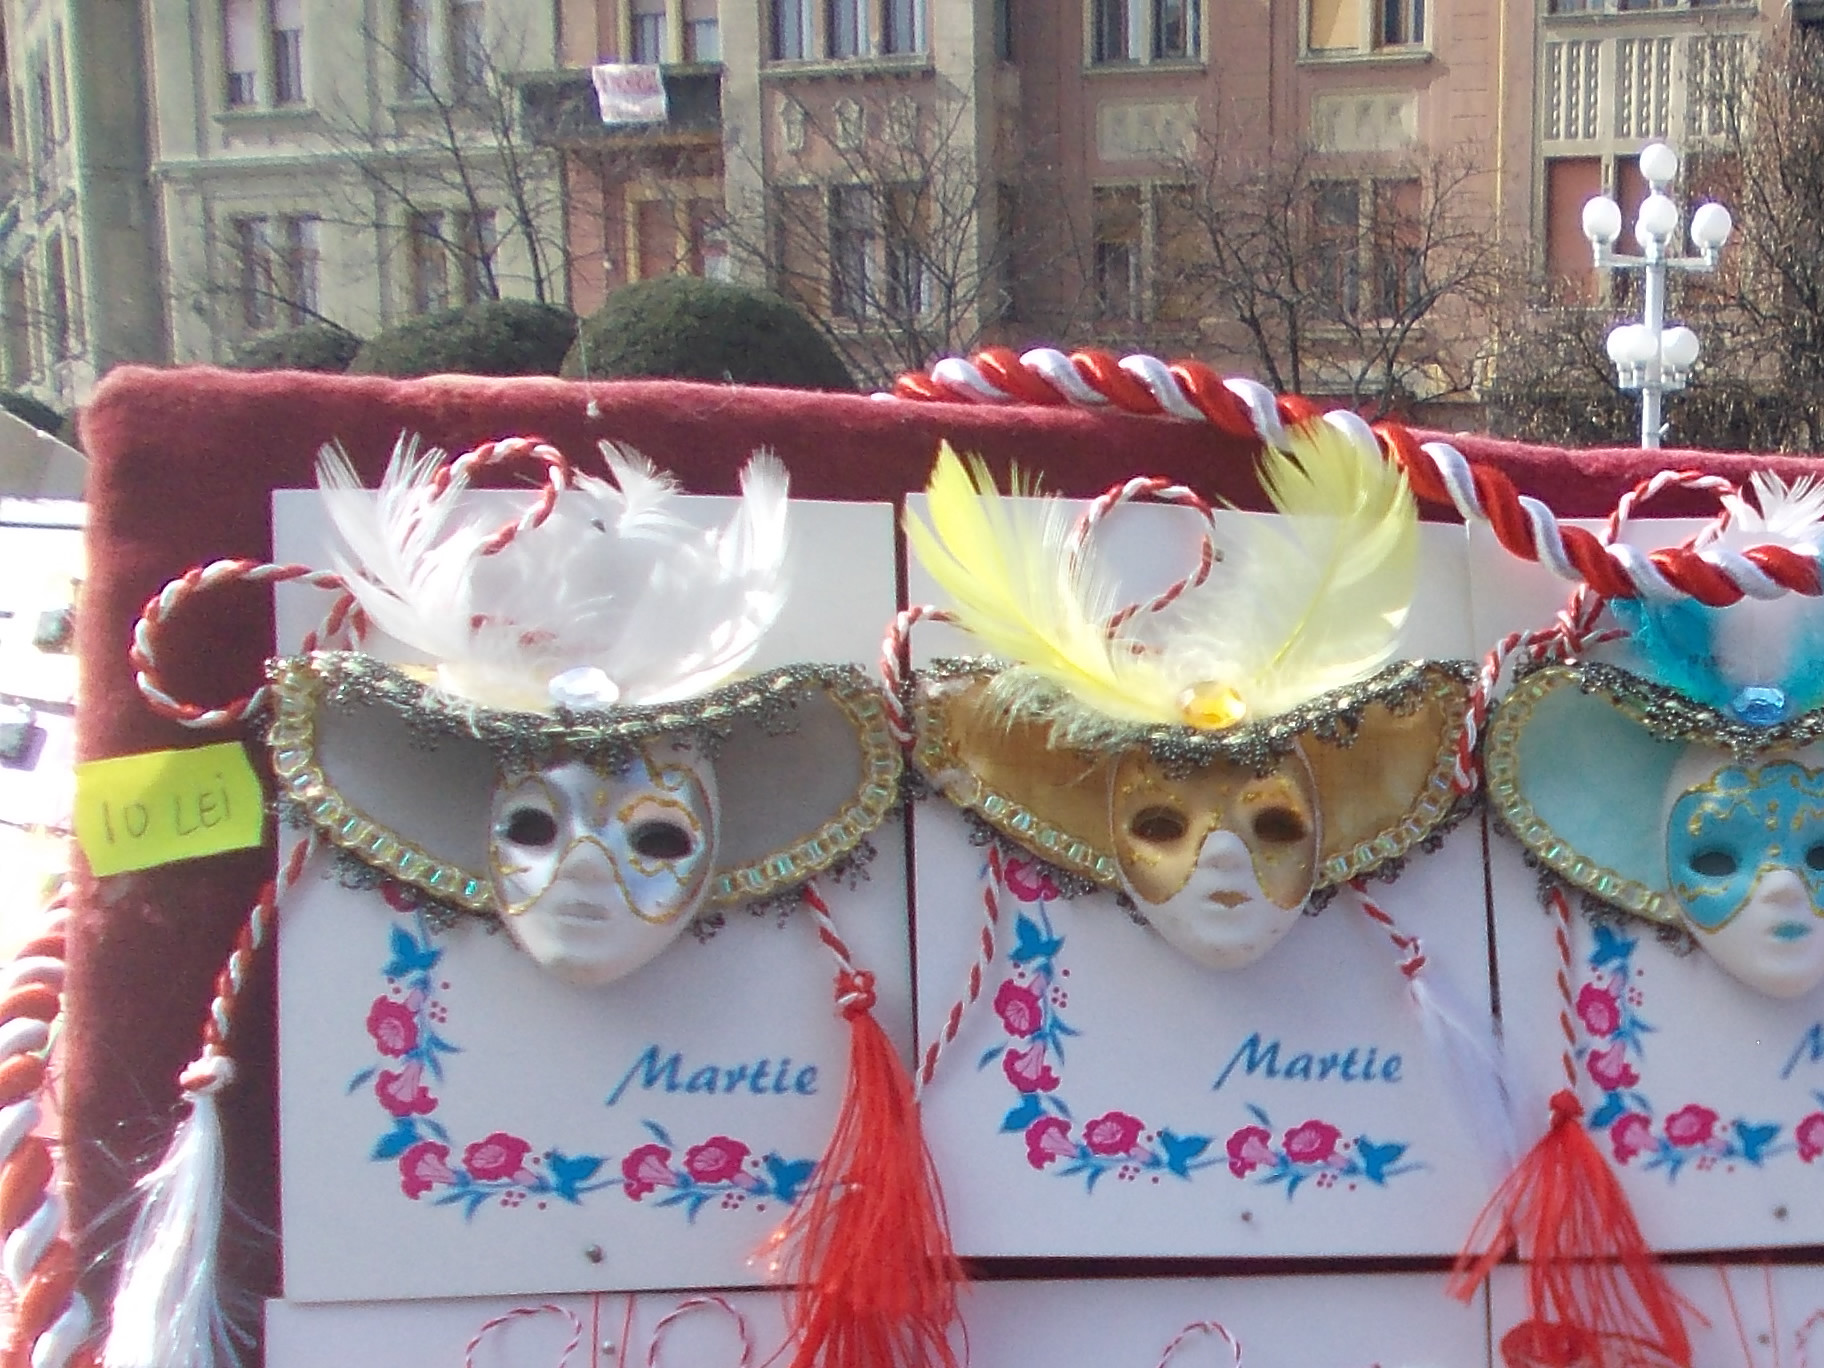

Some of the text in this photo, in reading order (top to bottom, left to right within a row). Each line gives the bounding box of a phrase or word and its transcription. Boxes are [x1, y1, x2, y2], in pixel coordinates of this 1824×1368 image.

[102, 799, 149, 846] 10
[605, 1044, 818, 1106] Martie
[1211, 1031, 1403, 1092] Martie
